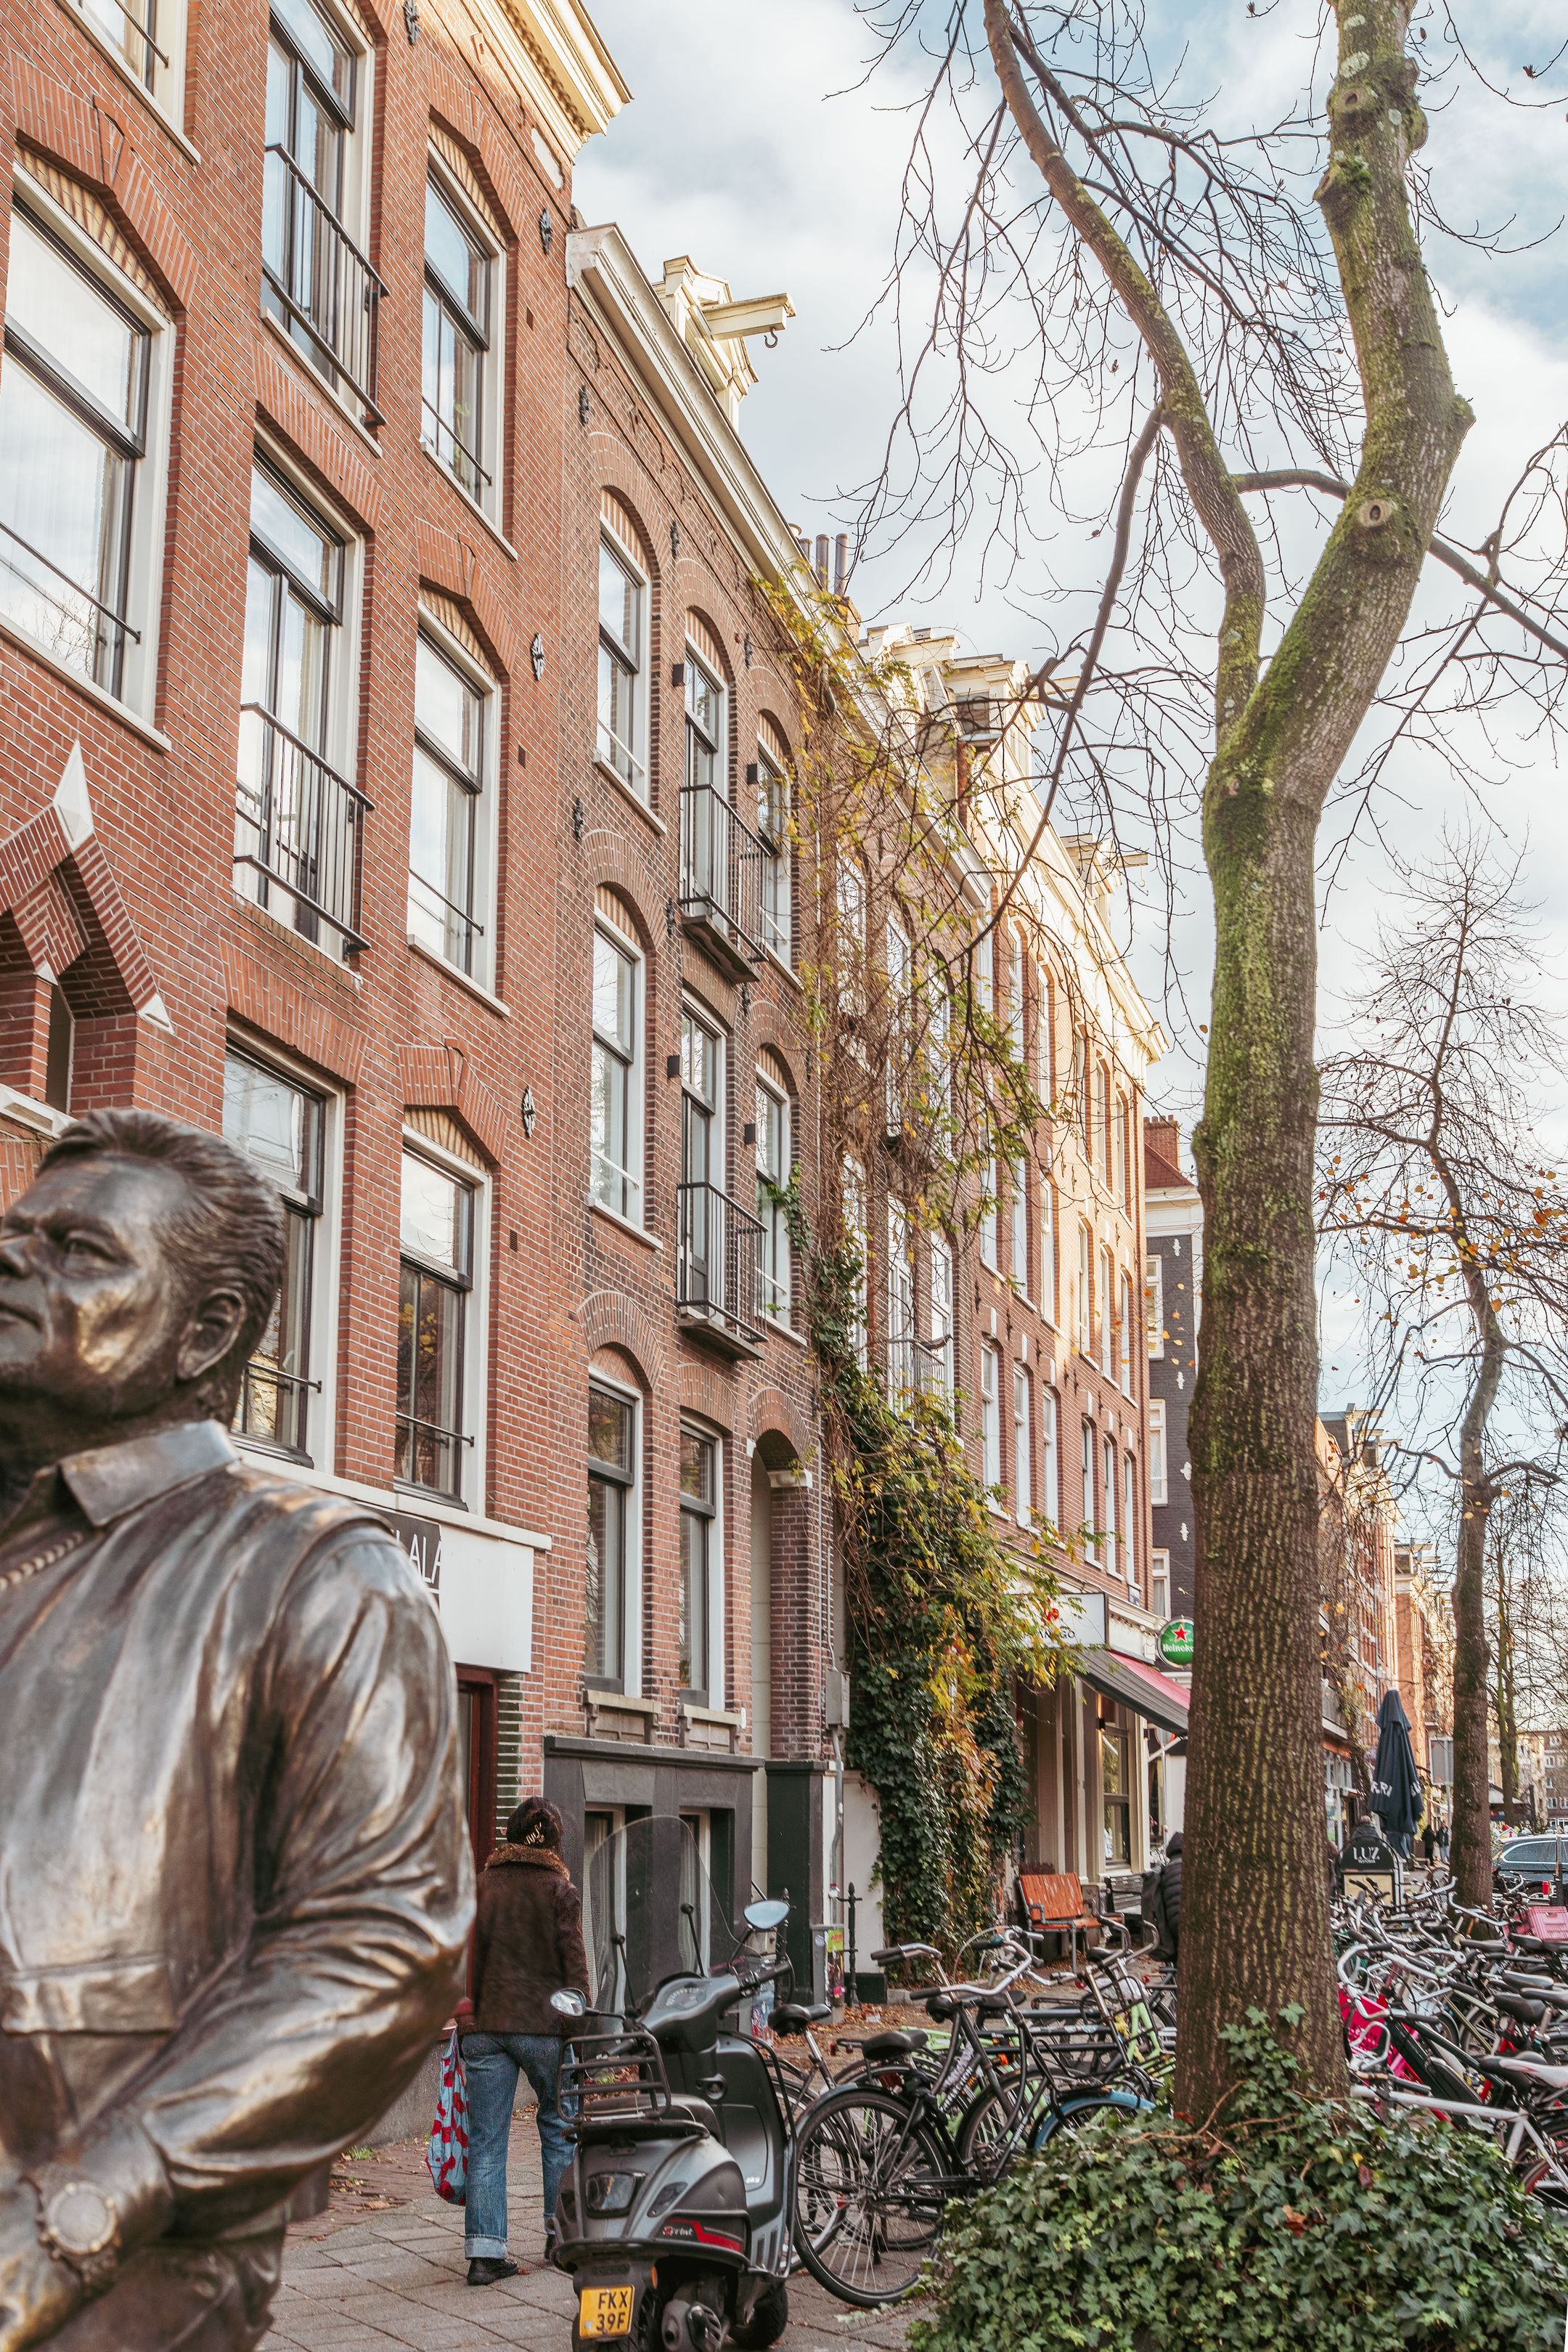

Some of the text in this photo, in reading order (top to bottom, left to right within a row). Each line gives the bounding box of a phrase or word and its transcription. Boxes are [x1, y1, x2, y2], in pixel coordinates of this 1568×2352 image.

[1162, 1643, 1194, 1653] Heineke
[1352, 1847, 1380, 1860] LUZ
[598, 2290, 628, 2309] FKX
[596, 2312, 626, 2331] 39F
